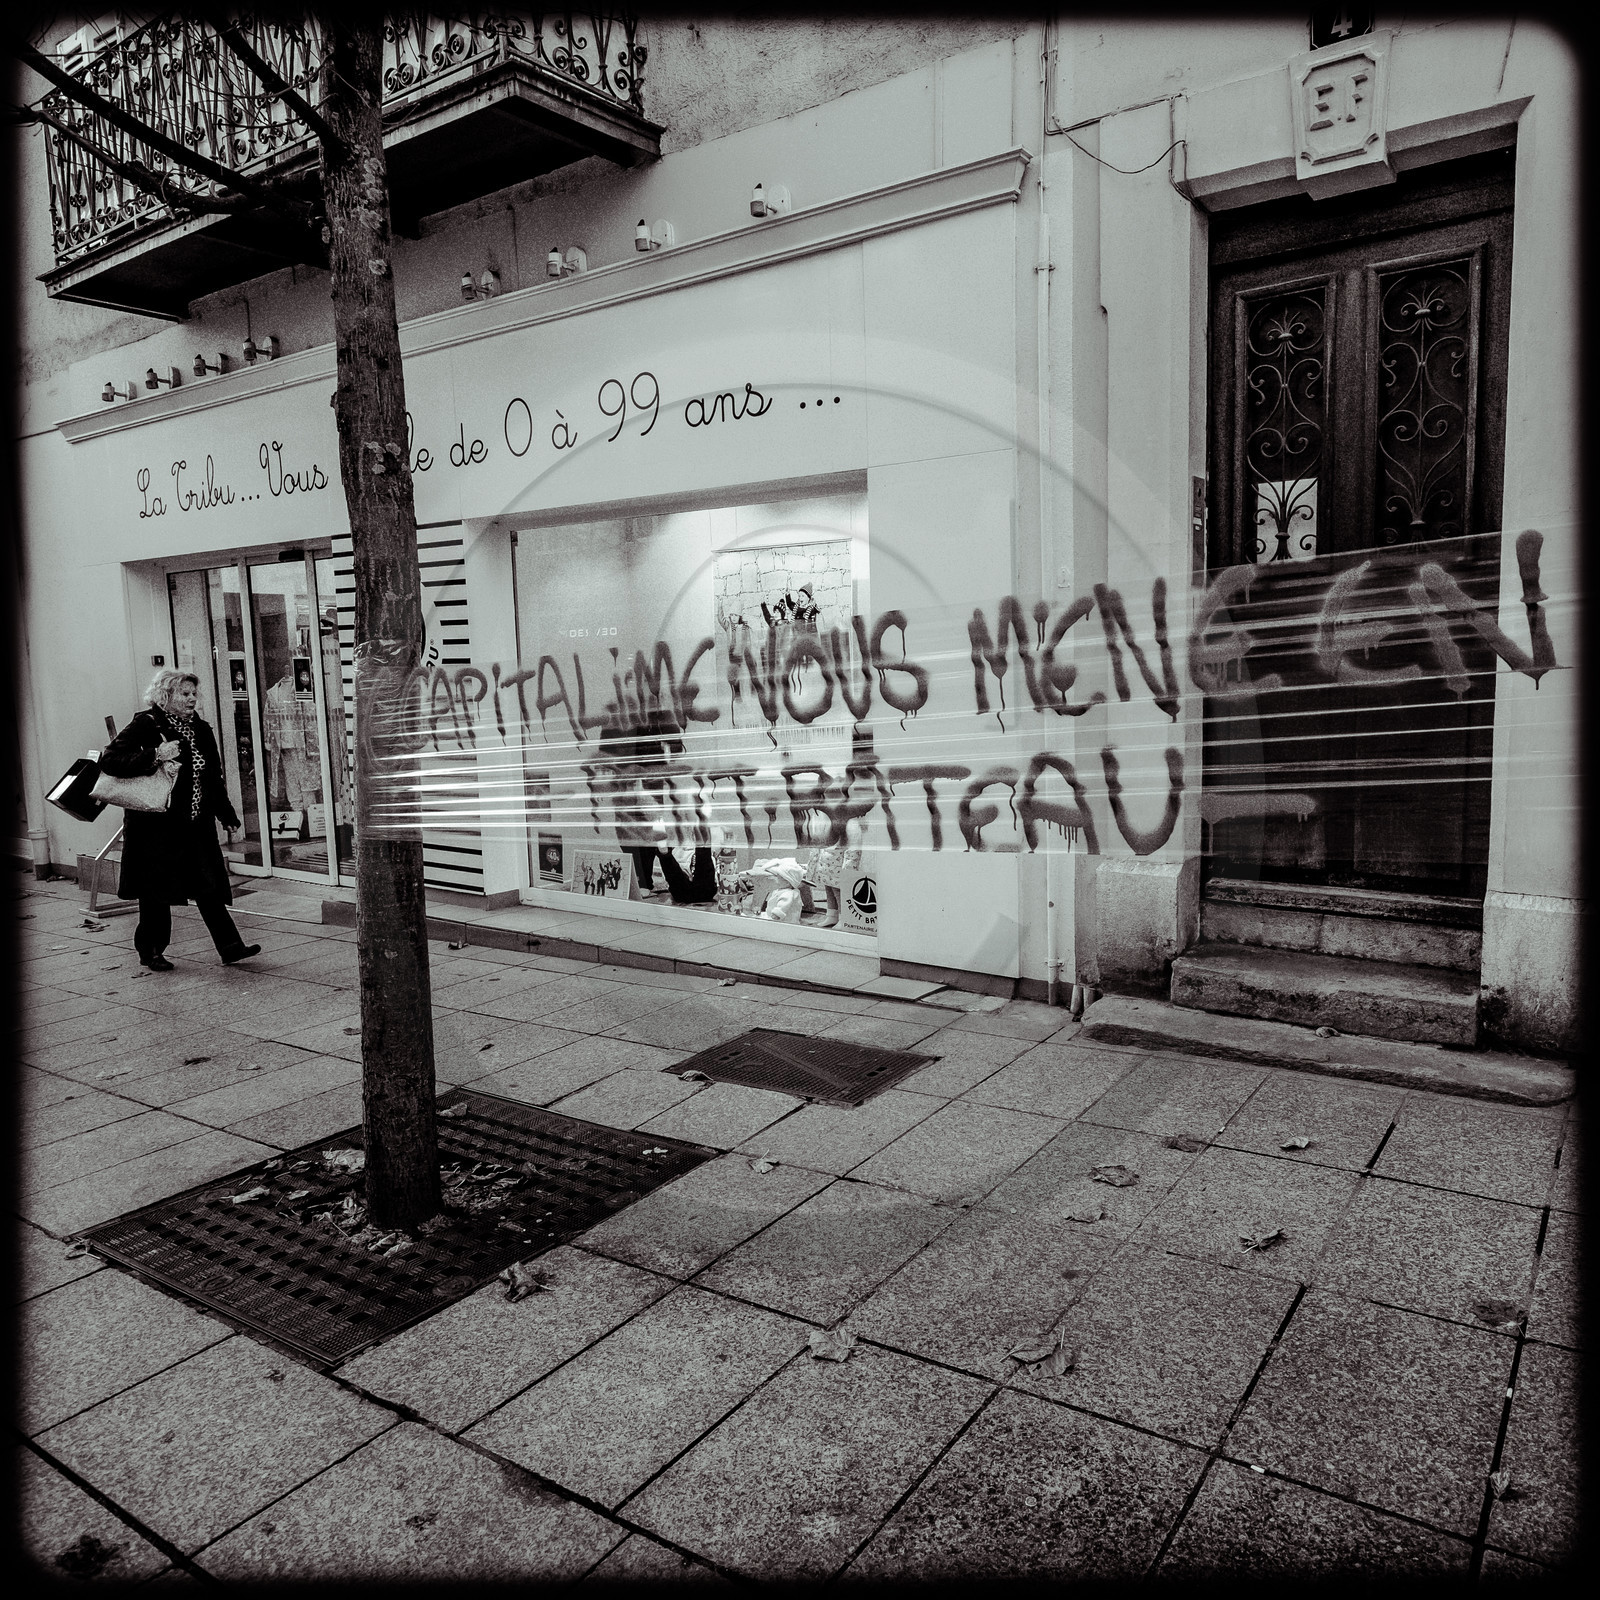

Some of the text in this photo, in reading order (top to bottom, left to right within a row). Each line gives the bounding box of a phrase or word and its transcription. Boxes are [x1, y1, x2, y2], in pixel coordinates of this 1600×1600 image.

[1330, 7, 1353, 38] 4
[136, 467, 168, 519] La
[259, 440, 329, 497] Vous
[449, 422, 489, 468] de
[551, 409, 578, 450] à
[597, 371, 660, 443] 99
[684, 382, 773, 428] ans
[726, 609, 930, 725] NOUS
[782, 746, 1184, 856] BATEAU
[846, 899, 862, 920] PETIT
